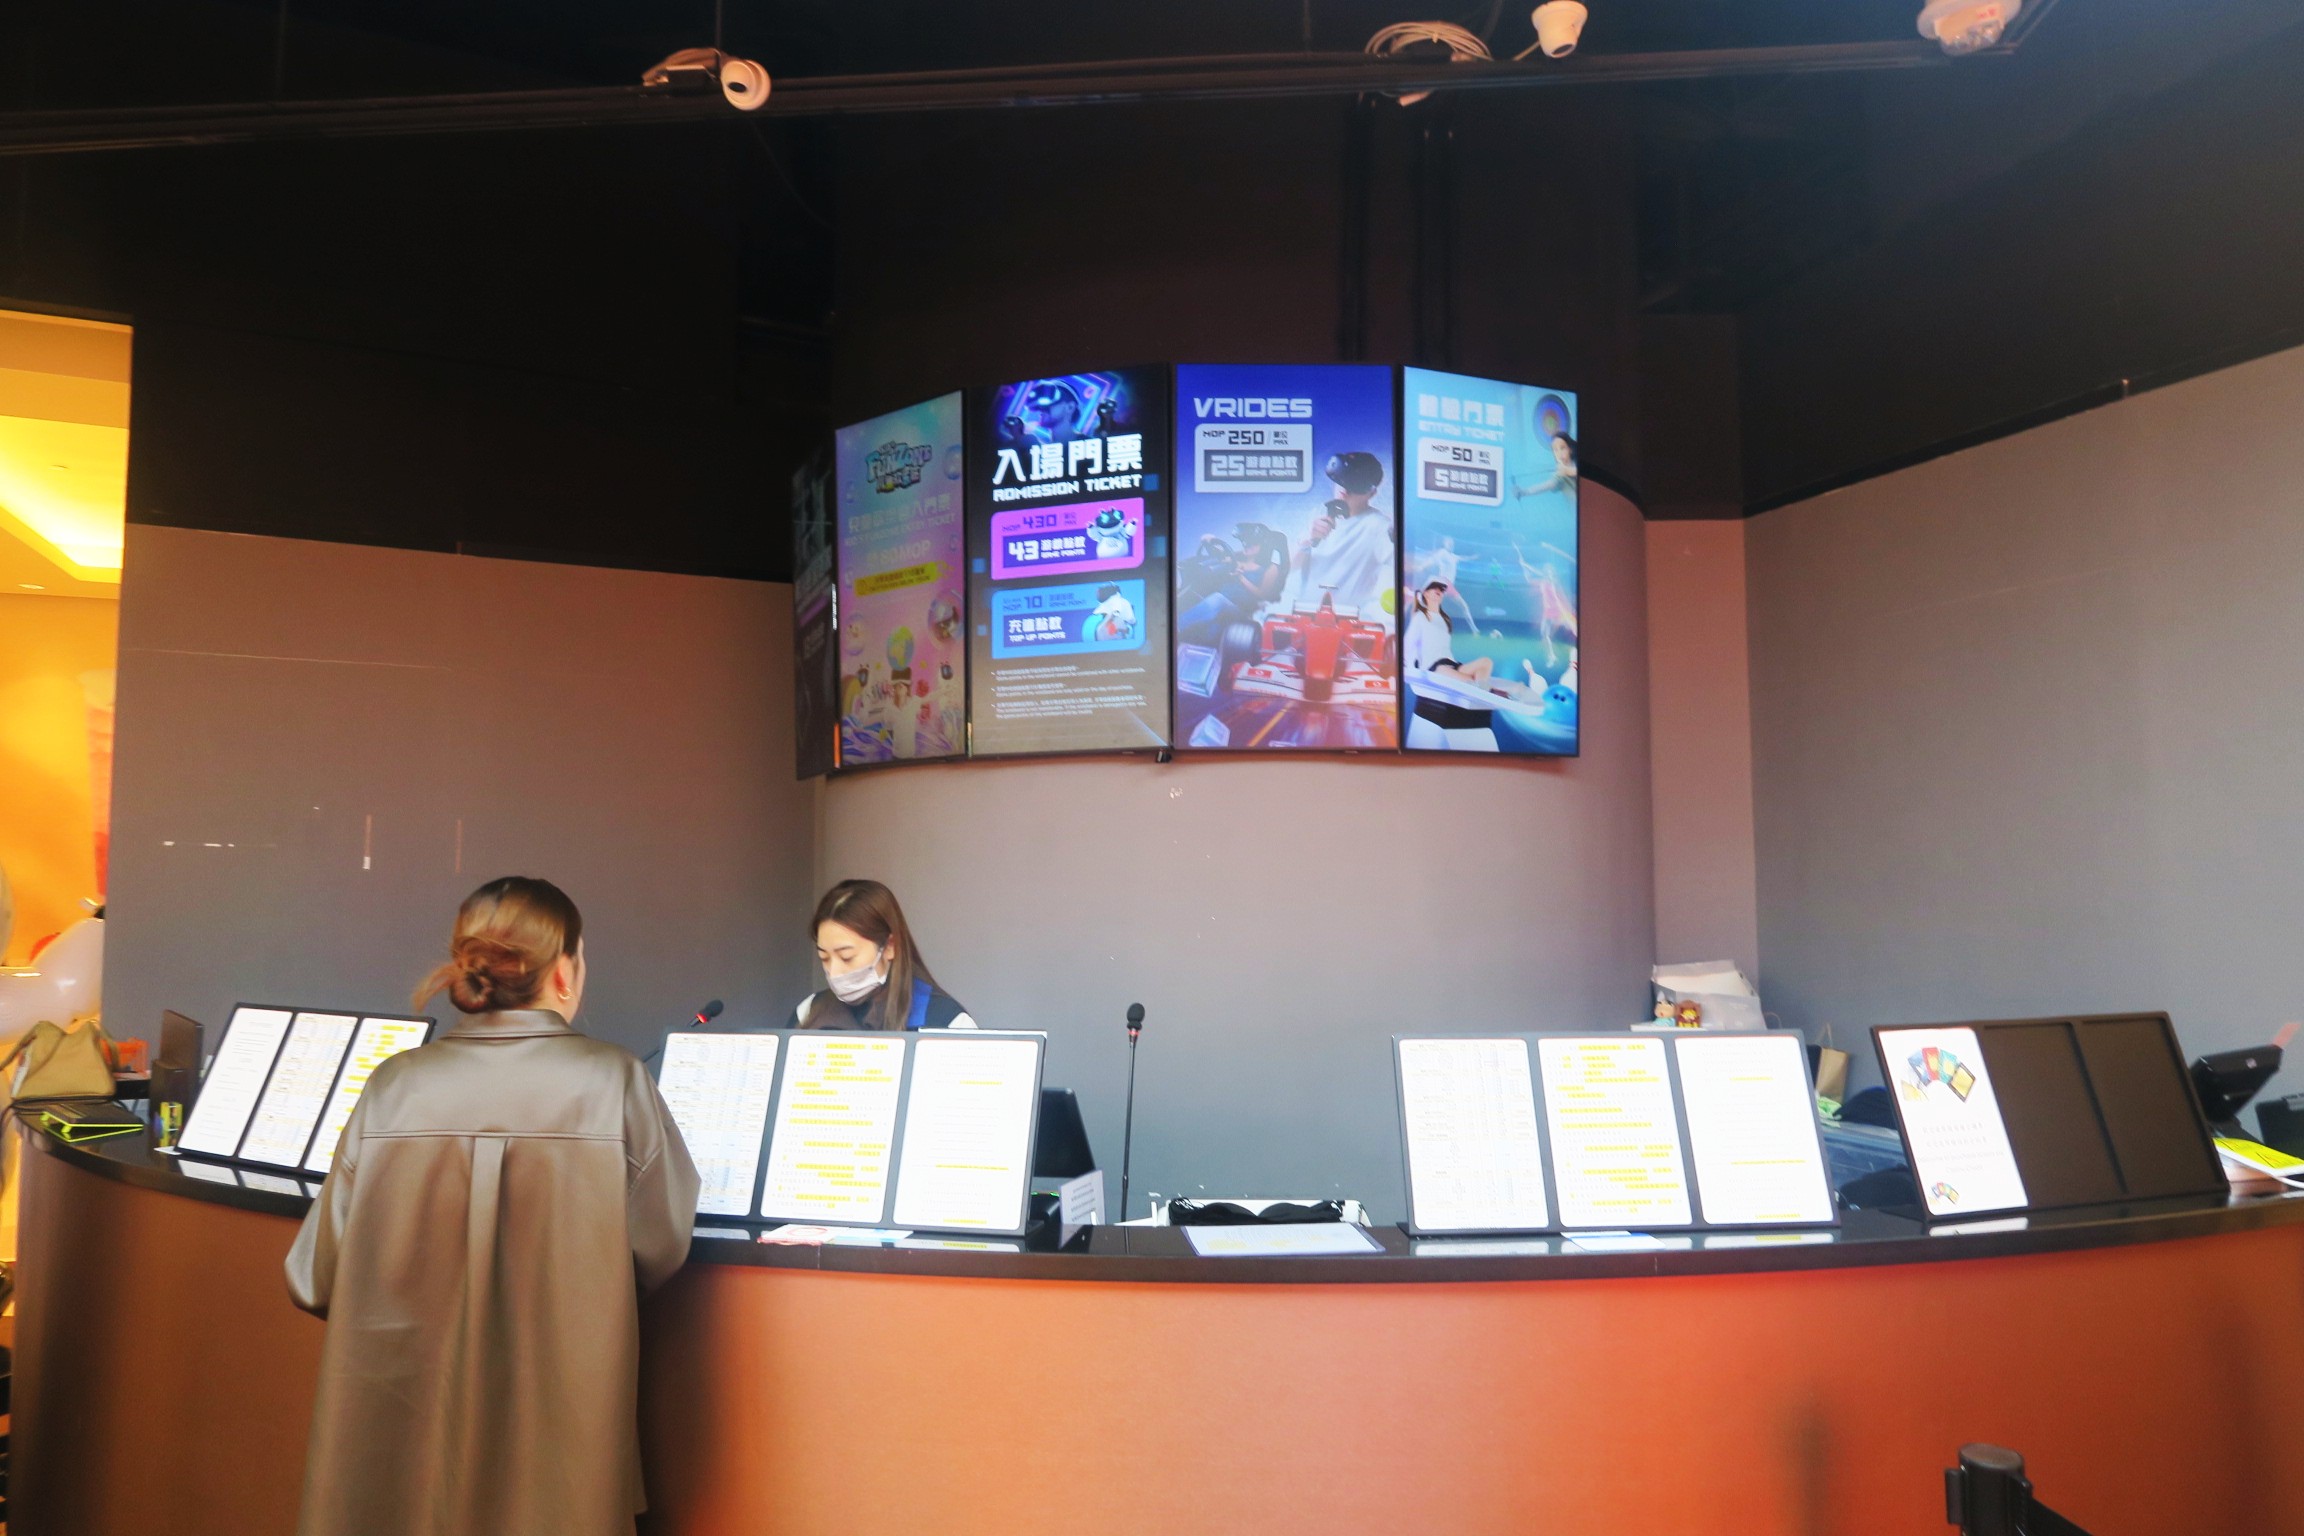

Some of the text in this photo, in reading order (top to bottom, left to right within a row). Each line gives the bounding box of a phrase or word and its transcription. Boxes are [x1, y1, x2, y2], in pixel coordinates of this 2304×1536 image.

[1193, 397, 1313, 418] VRIDES
[1228, 430, 1265, 445] 250
[992, 433, 1143, 485] 入場門票
[1452, 446, 1473, 462] 50
[1211, 454, 1245, 477] 25
[992, 473, 1143, 503] ADMISSION TICKET
[1434, 467, 1450, 488] 5
[1022, 513, 1058, 530] 430
[1008, 540, 1040, 562] 43
[1023, 595, 1043, 610] 10
